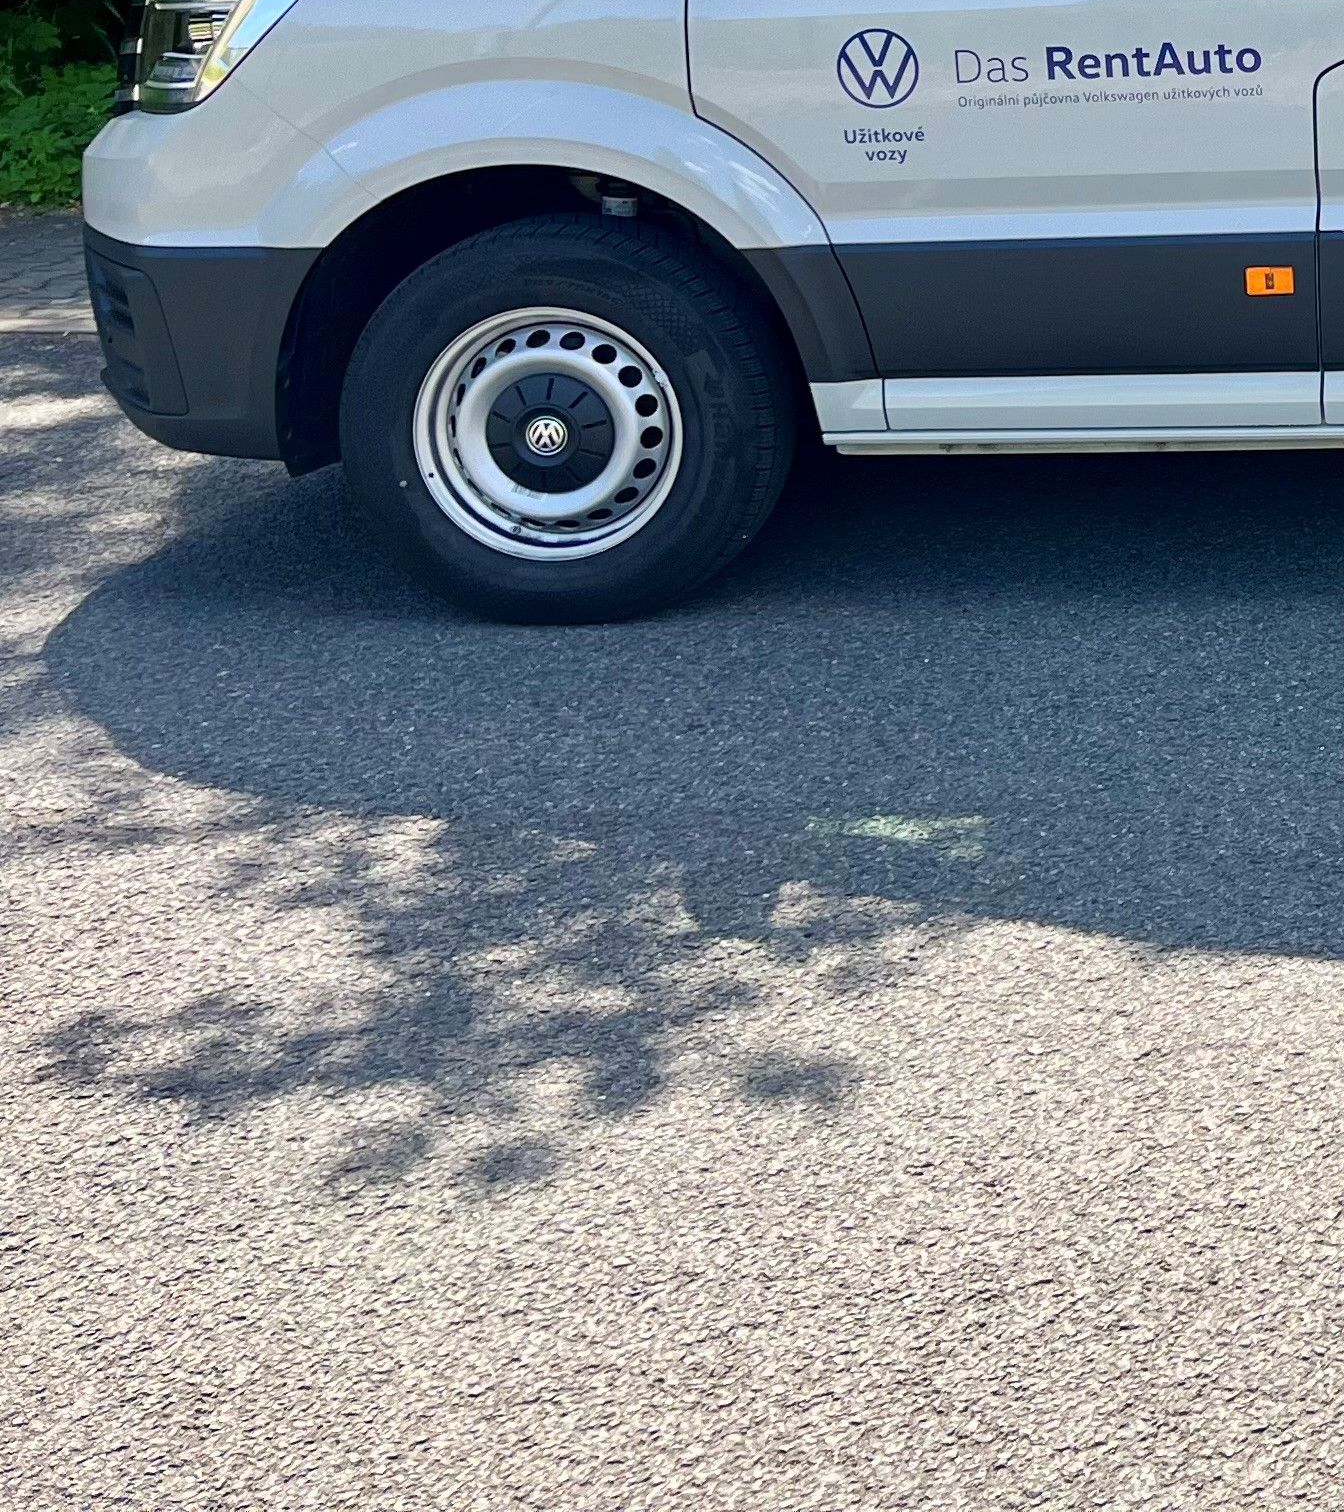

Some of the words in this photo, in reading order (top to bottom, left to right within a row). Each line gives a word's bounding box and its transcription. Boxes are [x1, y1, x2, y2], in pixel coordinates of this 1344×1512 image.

[954, 49, 1030, 84] Das
[1045, 41, 1263, 81] RentAuto
[957, 93, 1020, 111] Originální
[1023, 90, 1081, 109] půjčovna
[1082, 89, 1160, 105] Volkswagen
[1163, 85, 1231, 103] užitkových
[1233, 84, 1264, 98] vozů
[843, 125, 925, 145] Užitkové
[864, 148, 908, 165] vozy
